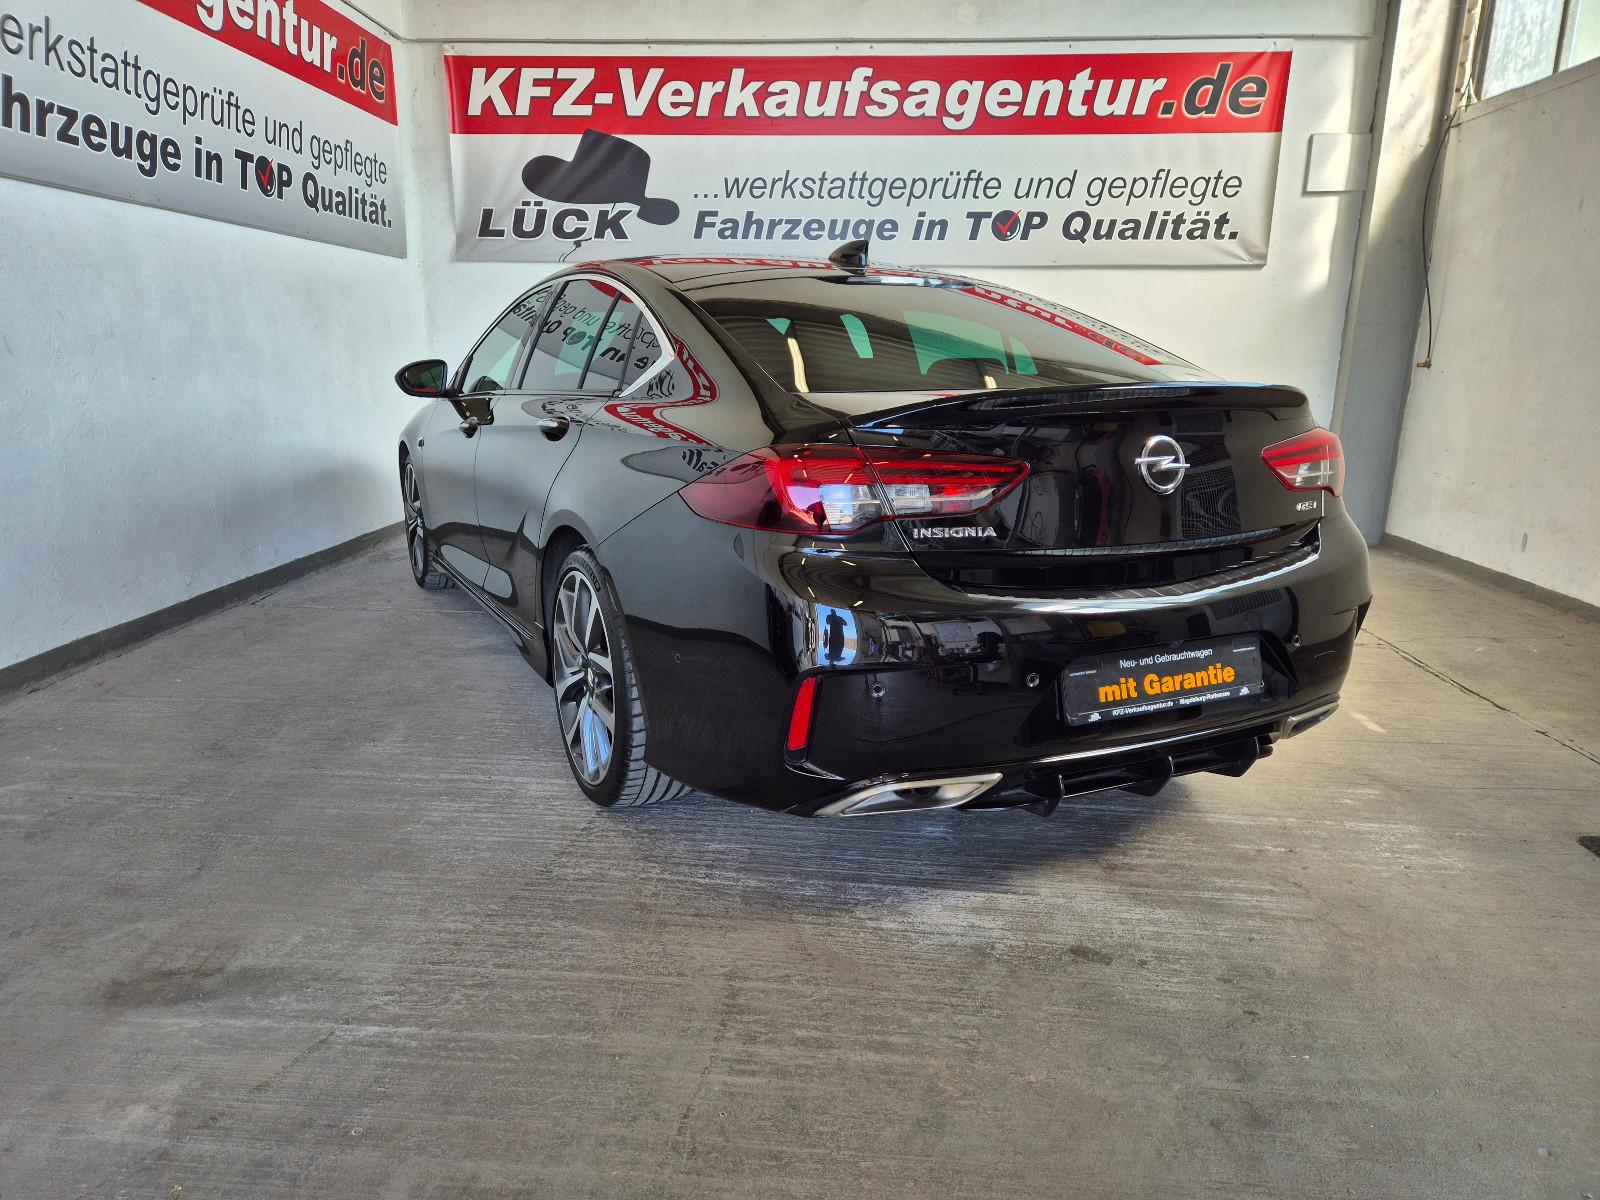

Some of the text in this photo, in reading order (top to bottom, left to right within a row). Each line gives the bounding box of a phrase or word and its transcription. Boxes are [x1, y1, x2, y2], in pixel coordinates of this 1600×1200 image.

[467, 63, 1268, 130] KFZ-Verkaufsagentur.de
[1, 73, 181, 178] hrzeuge
[194, 136, 223, 183] in
[302, 172, 392, 228] Qualität.
[265, 115, 303, 154] und
[310, 134, 387, 186] gepflegte
[693, 169, 1242, 206] ...werkstattgeprüfte und gepflegte
[478, 200, 632, 240] LÜCK
[694, 210, 899, 242] Fahrzeuge
[912, 211, 948, 241] in
[1062, 210, 1239, 243] Qualität.
[912, 527, 997, 538] INSIGNIA
[1120, 648, 1213, 668] Neu- und Gebrauchtwagen
[1099, 663, 1236, 702] mit Garantie
